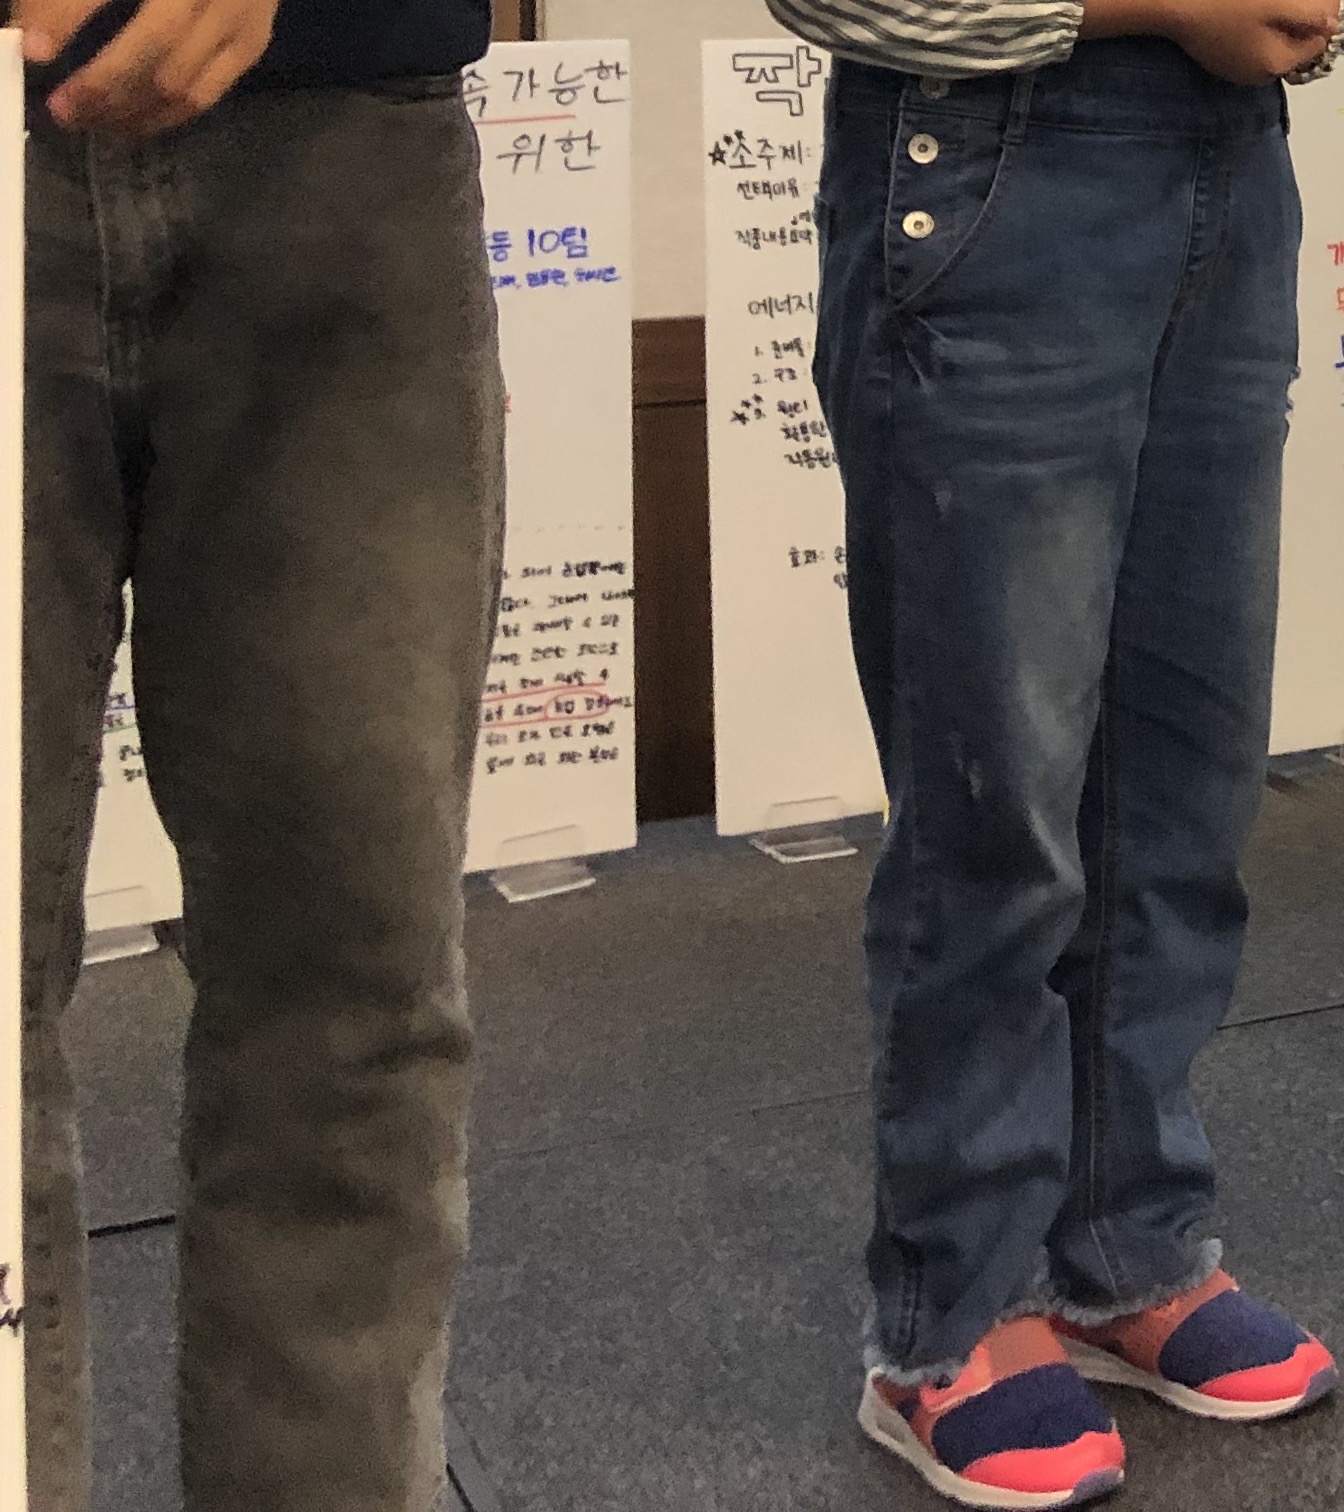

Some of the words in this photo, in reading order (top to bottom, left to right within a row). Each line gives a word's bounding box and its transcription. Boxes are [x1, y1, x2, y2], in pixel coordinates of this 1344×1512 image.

[504, 59, 629, 106] 가능한
[496, 130, 602, 175] 위한
[527, 226, 589, 260] 10팀
